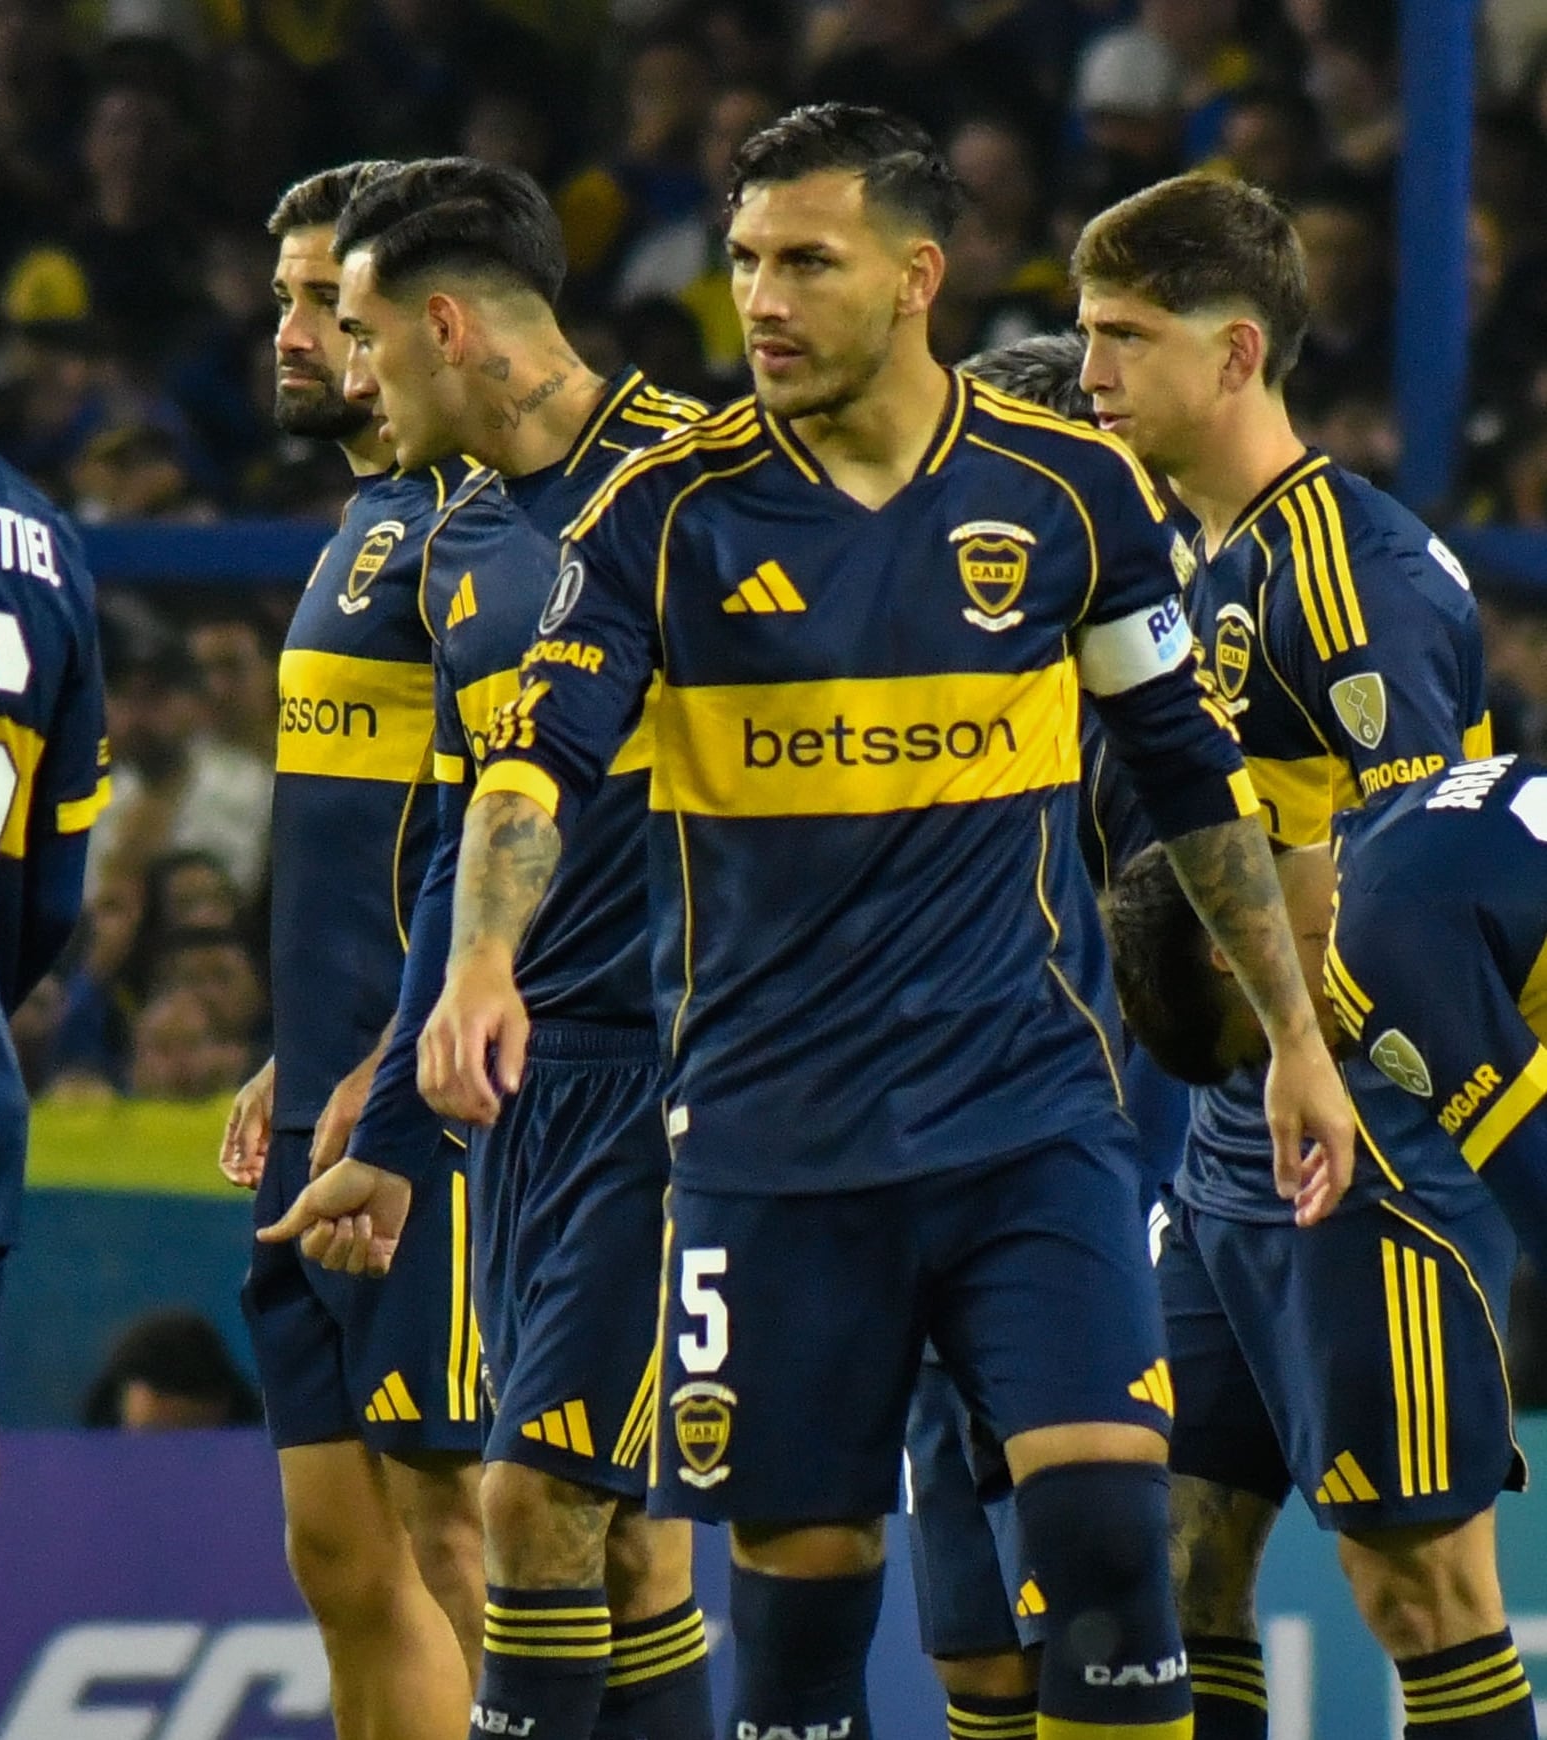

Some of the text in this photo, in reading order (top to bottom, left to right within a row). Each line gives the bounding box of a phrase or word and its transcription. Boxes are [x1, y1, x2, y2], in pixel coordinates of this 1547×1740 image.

[970, 566, 1015, 579] CABJ
[1221, 652, 1247, 666] CABJ
[743, 714, 1017, 769] betsson
[677, 1248, 729, 1374] 5
[1084, 1651, 1188, 1686] CABJ
